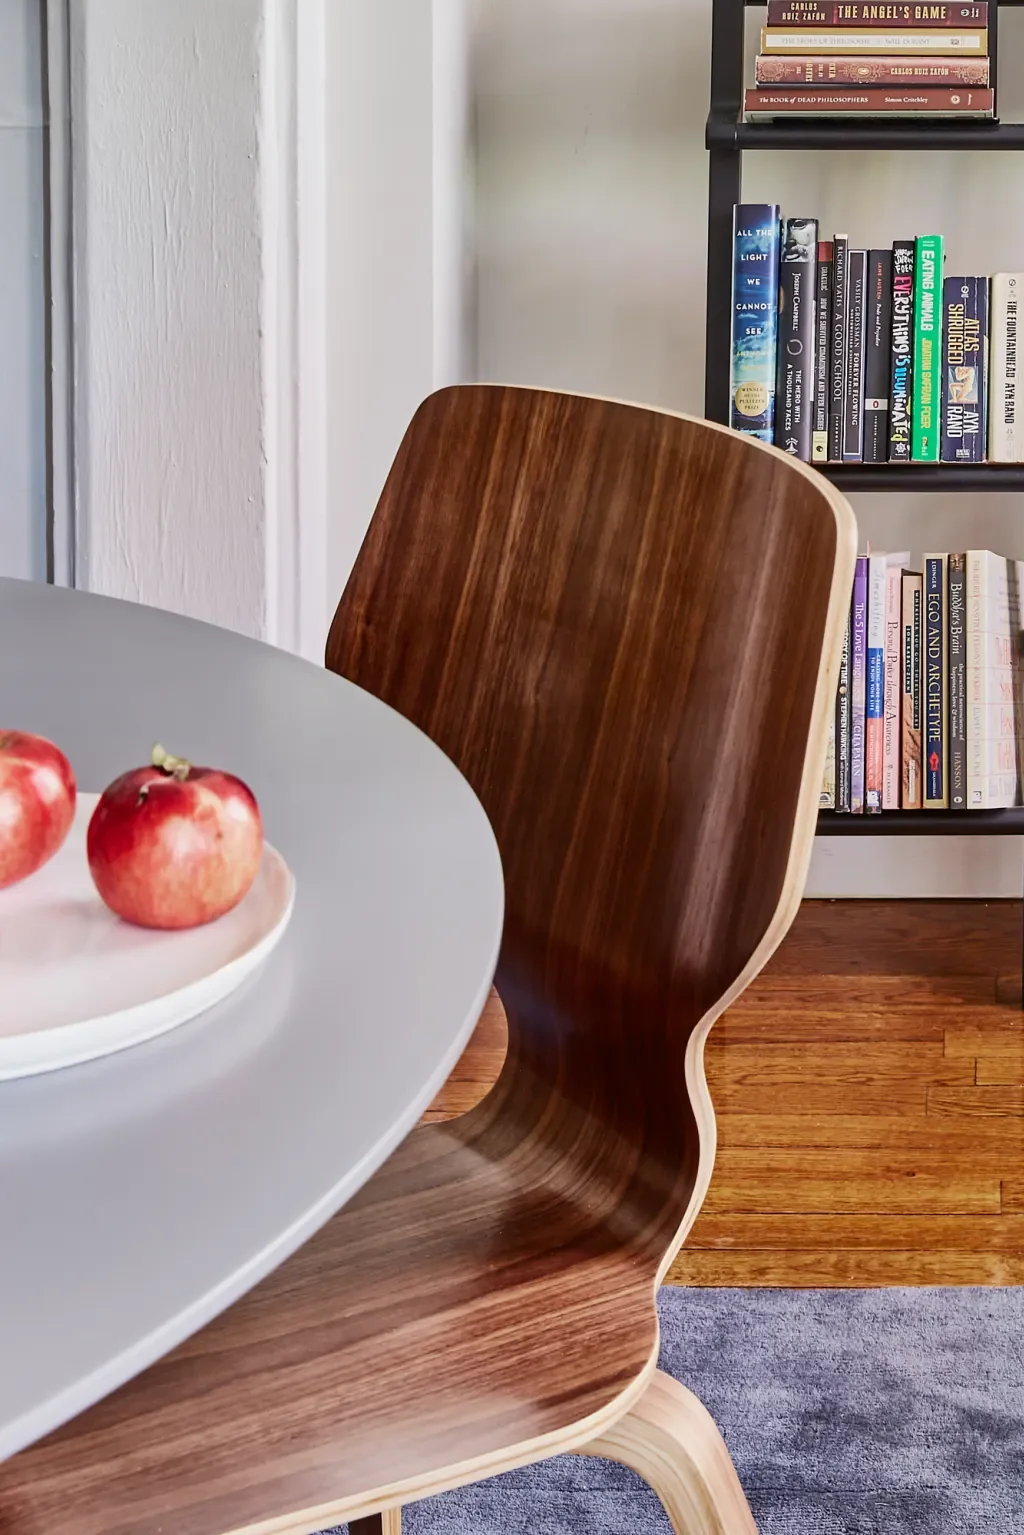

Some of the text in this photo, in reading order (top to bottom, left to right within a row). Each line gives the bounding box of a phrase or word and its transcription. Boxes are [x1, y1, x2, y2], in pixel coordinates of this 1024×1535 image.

[838, 5, 946, 19] THE ANGEL'S GAME
[921, 250, 934, 428] EATING ANIMALS JONATHAN SAFRAN FOER
[948, 304, 965, 364] SHRUGGED
[964, 318, 979, 352] ATLAS
[1004, 301, 1017, 424] THE FOUNTAINHEAD AYN RAND
[947, 406, 963, 437] RAND
[963, 411, 979, 433] AYN
[951, 583, 962, 654] Buddha's Brain
[928, 593, 940, 742] EGO AND ARCHETYPE
[954, 751, 962, 789] HANSON
